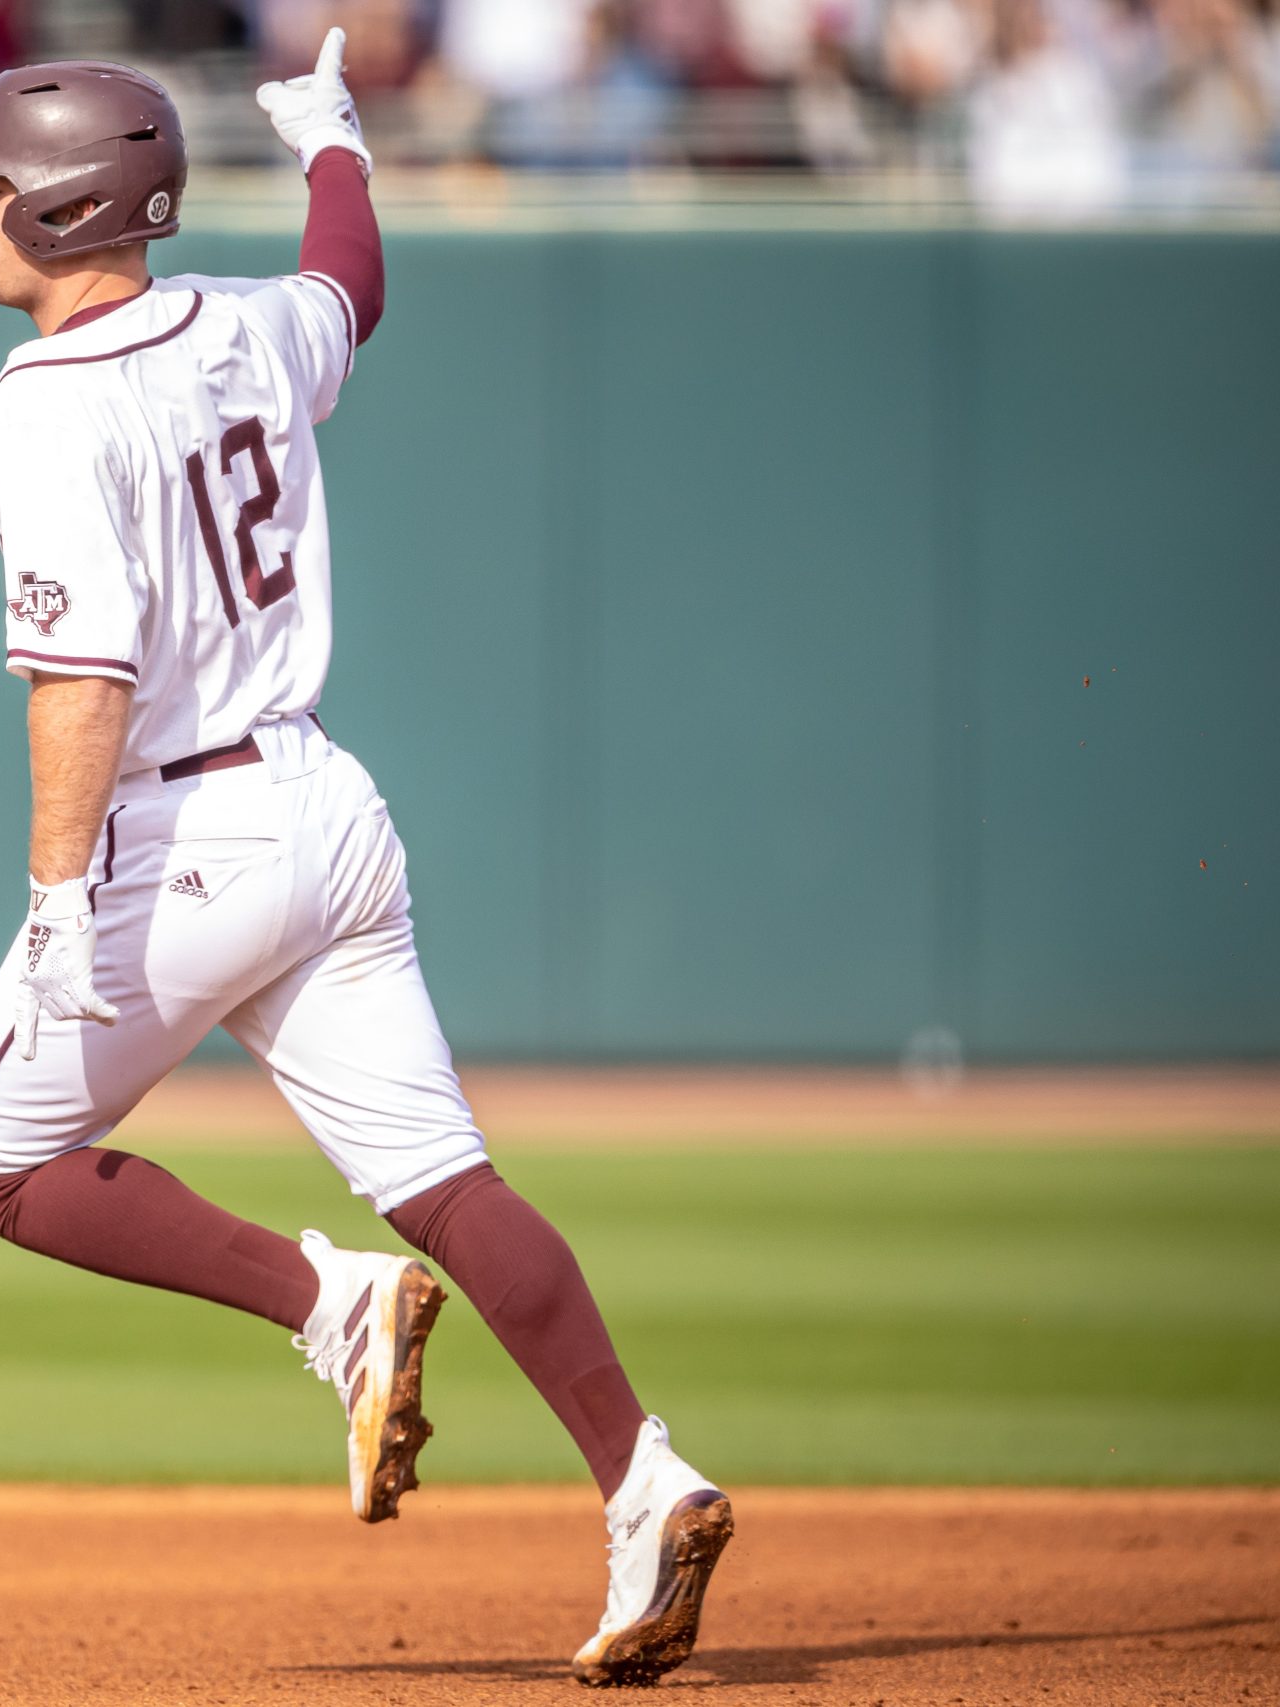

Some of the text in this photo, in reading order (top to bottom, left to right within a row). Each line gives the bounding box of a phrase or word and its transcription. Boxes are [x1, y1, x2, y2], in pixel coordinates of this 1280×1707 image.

[150, 195, 168, 220] SEC
[186, 415, 297, 630] 12
[168, 884, 209, 900] adidas
[28, 924, 52, 973] adidas
